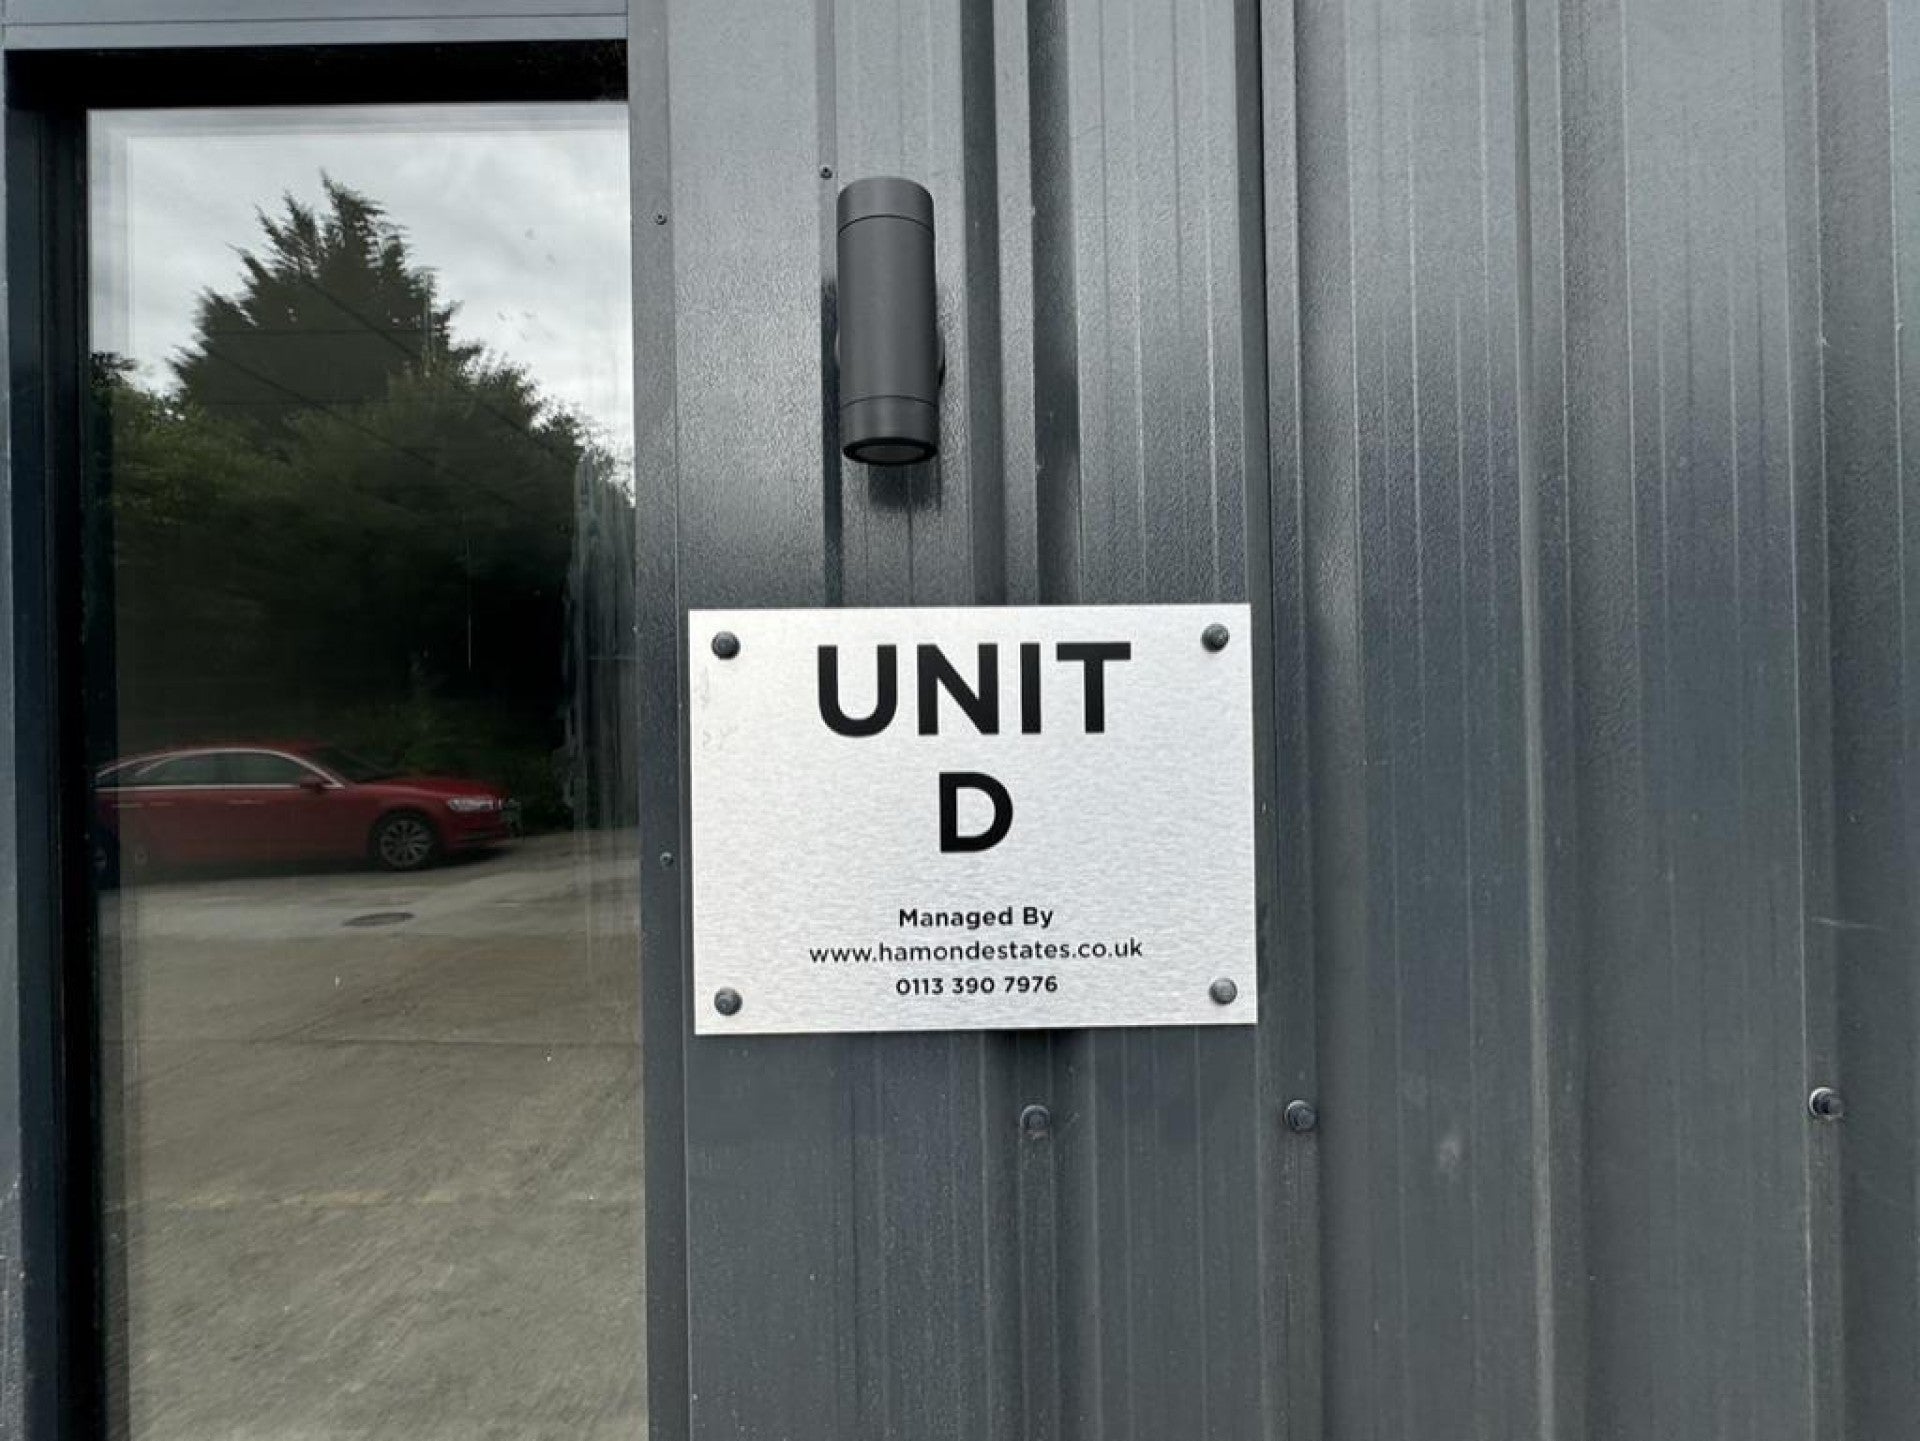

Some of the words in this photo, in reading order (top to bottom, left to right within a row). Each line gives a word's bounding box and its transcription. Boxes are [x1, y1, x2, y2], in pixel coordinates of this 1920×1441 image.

[817, 641, 1132, 738] UNIT
[938, 770, 1014, 854] D
[898, 905, 1013, 930] Managed
[1022, 905, 1054, 928] By
[808, 936, 1143, 963] www.hamondestates.co.uk
[895, 976, 944, 996] 0113
[951, 976, 995, 994] 390
[1003, 974, 1059, 994] 7976
